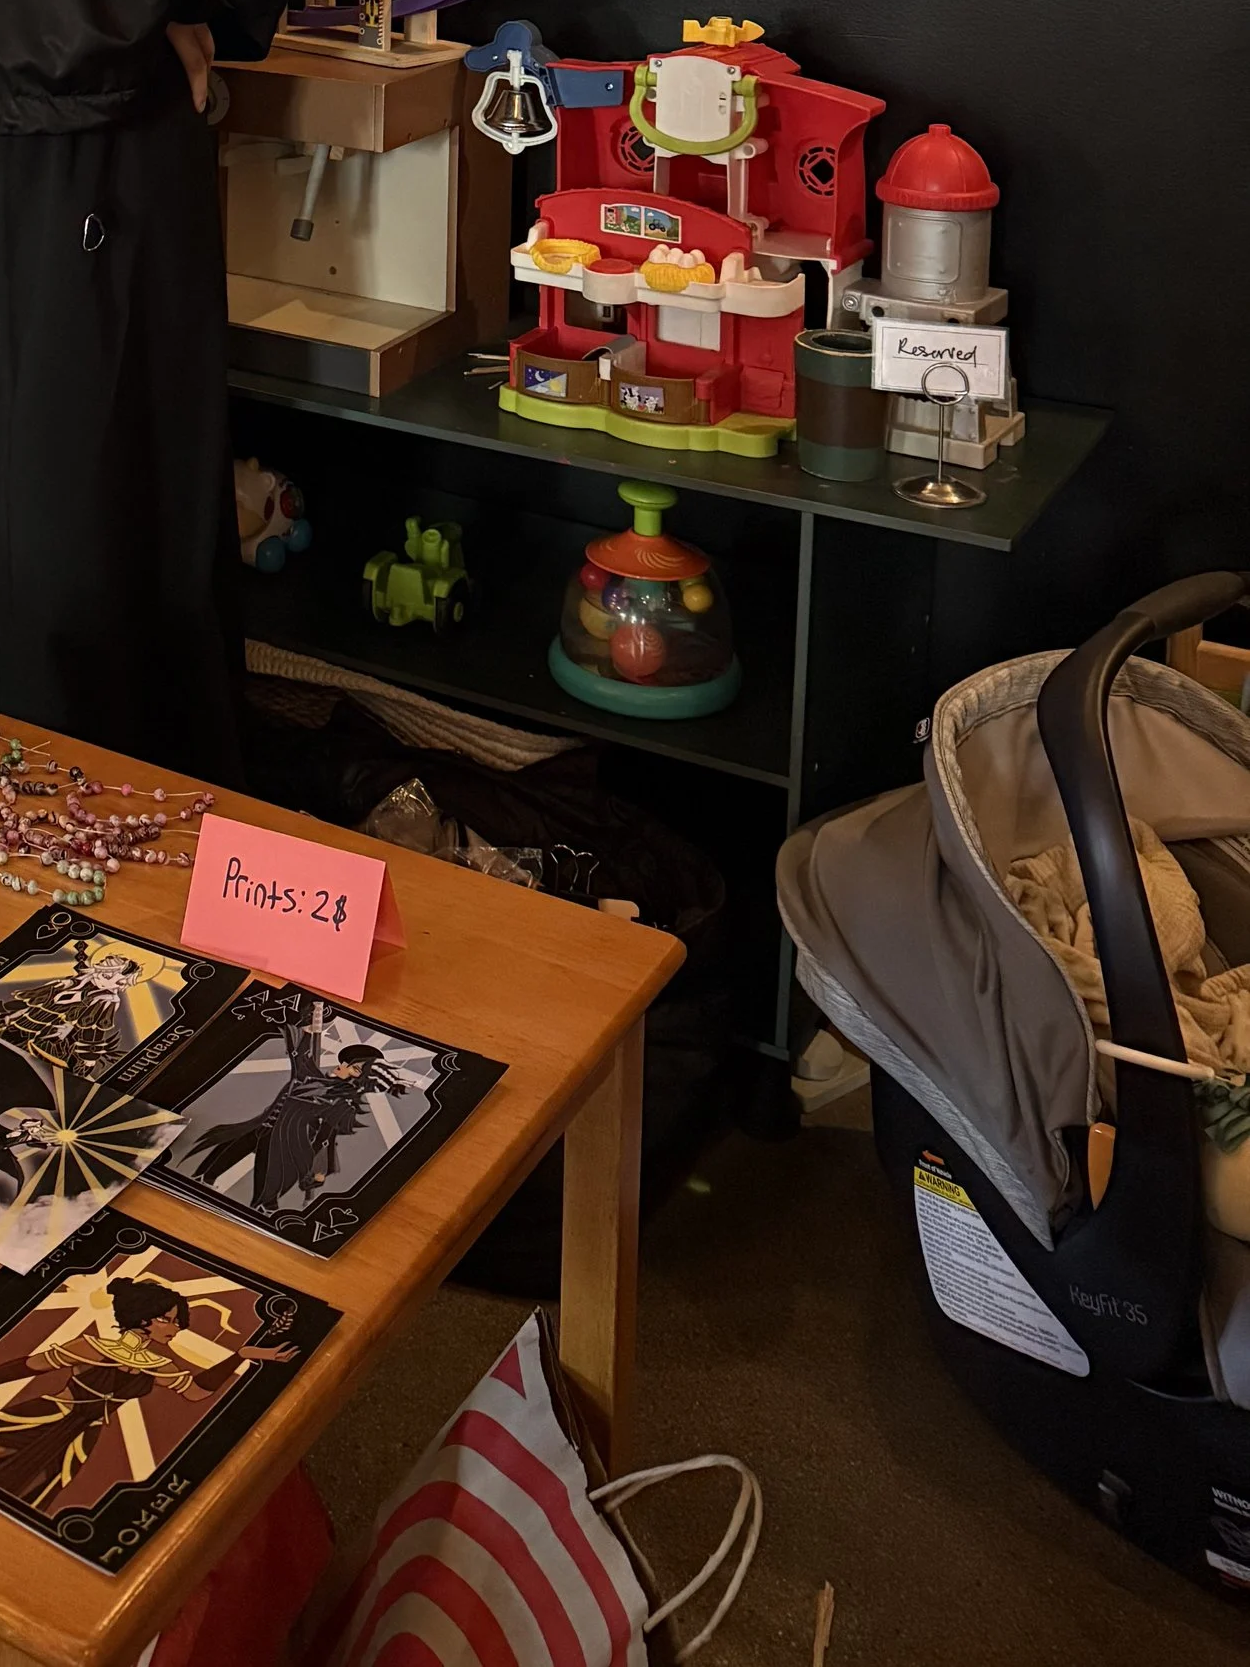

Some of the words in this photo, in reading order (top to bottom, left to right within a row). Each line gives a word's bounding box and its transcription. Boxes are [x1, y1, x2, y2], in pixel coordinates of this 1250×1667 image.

[898, 337, 977, 368] Reserved
[222, 856, 304, 914] Prints:
[311, 889, 348, 932] 2$
[275, 993, 302, 1013] A
[117, 1025, 195, 1082] Seraphim
[924, 1172, 961, 1197] WARNING
[312, 1220, 344, 1243] A
[1123, 1300, 1148, 1326] 35
[99, 1473, 191, 1563] JOKER
